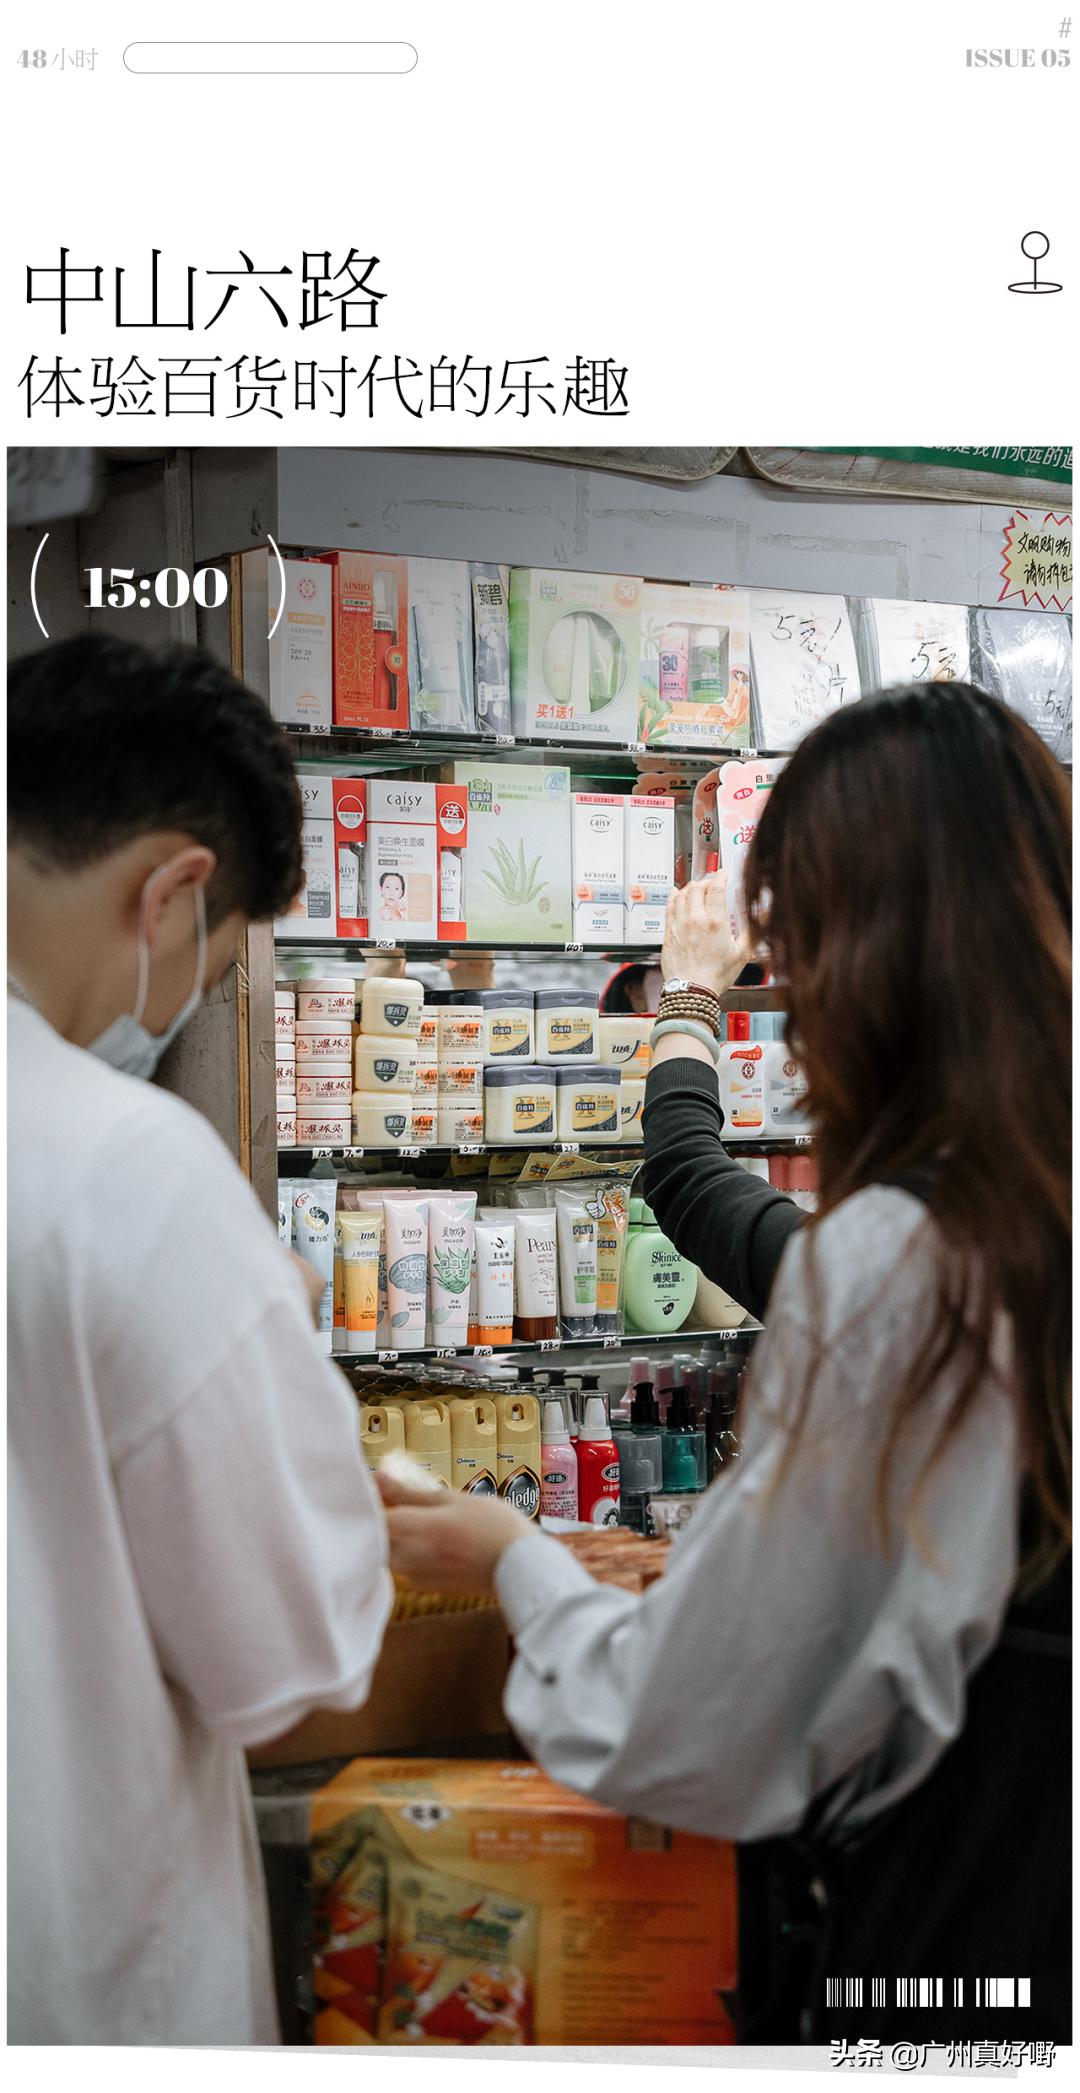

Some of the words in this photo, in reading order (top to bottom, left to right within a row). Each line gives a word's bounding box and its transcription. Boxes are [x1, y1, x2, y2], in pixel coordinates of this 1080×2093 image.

[1024, 559, 1072, 589] 请勿拆包
[662, 655, 678, 671] 30
[536, 703, 575, 719] 买1送1
[386, 791, 422, 806] caisy
[445, 804, 460, 818] 送
[589, 817, 611, 828] caisy
[643, 819, 663, 829] caisy
[401, 1228, 423, 1239] 美加净
[442, 1225, 466, 1238] 美加净
